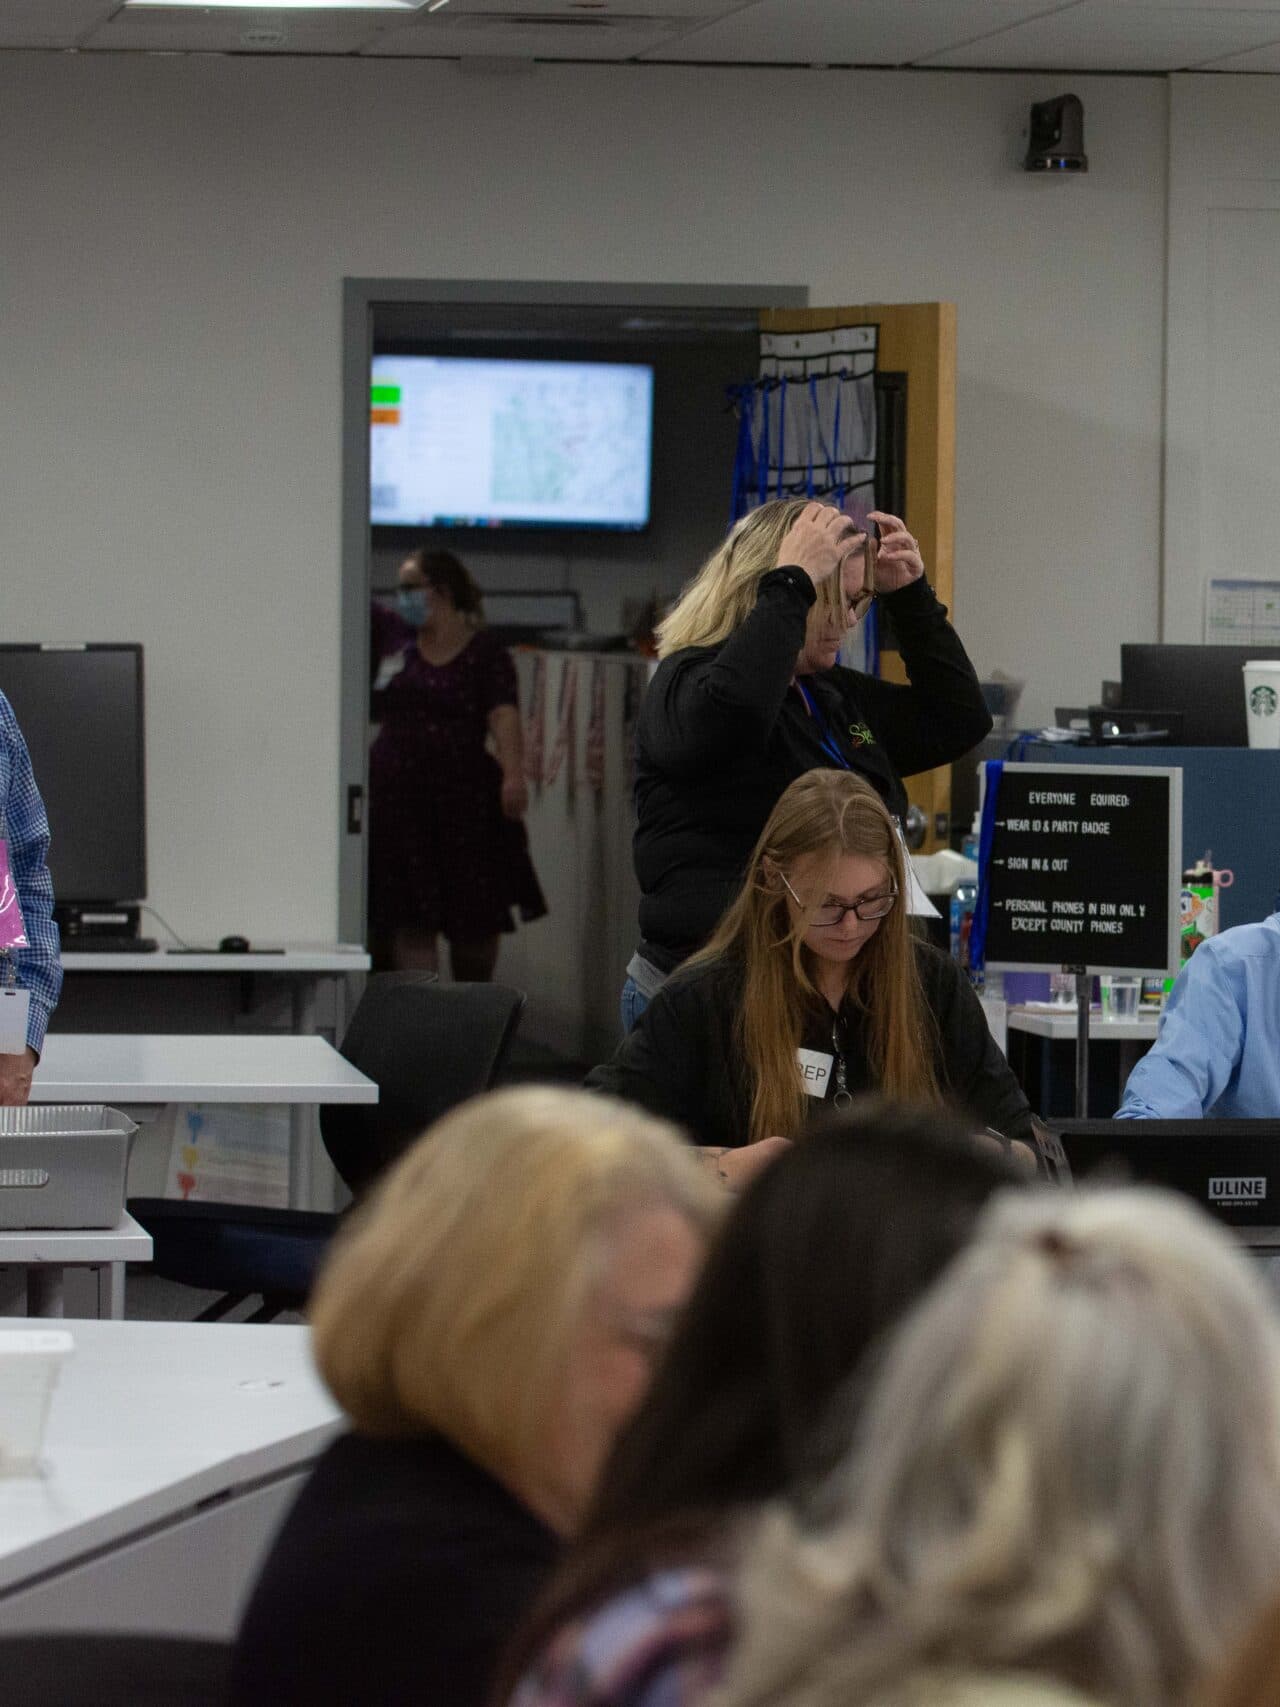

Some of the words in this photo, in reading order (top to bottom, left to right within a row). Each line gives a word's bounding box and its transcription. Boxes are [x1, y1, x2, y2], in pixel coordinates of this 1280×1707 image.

[1029, 791, 1076, 805] EVERYONE
[1007, 819, 1030, 832] WEAR
[1032, 820, 1042, 833] ID
[1043, 820, 1050, 833] &
[1052, 821, 1079, 833] PARTY
[1081, 821, 1110, 835] BADGE
[1008, 857, 1029, 870] SIGN
[1031, 858, 1041, 870] IN
[1042, 858, 1049, 871] &
[1051, 859, 1068, 871] OUT
[1005, 899, 1047, 913] PERSONAL
[1052, 901, 1085, 914] PHONES
[1088, 902, 1097, 915] IN
[1100, 903, 1116, 916] BIN
[1011, 917, 1047, 932] EXCEPT
[1050, 918, 1084, 933] COUNTY
[1090, 920, 1123, 934] PHONES
[1212, 1181, 1262, 1195] ULINE
